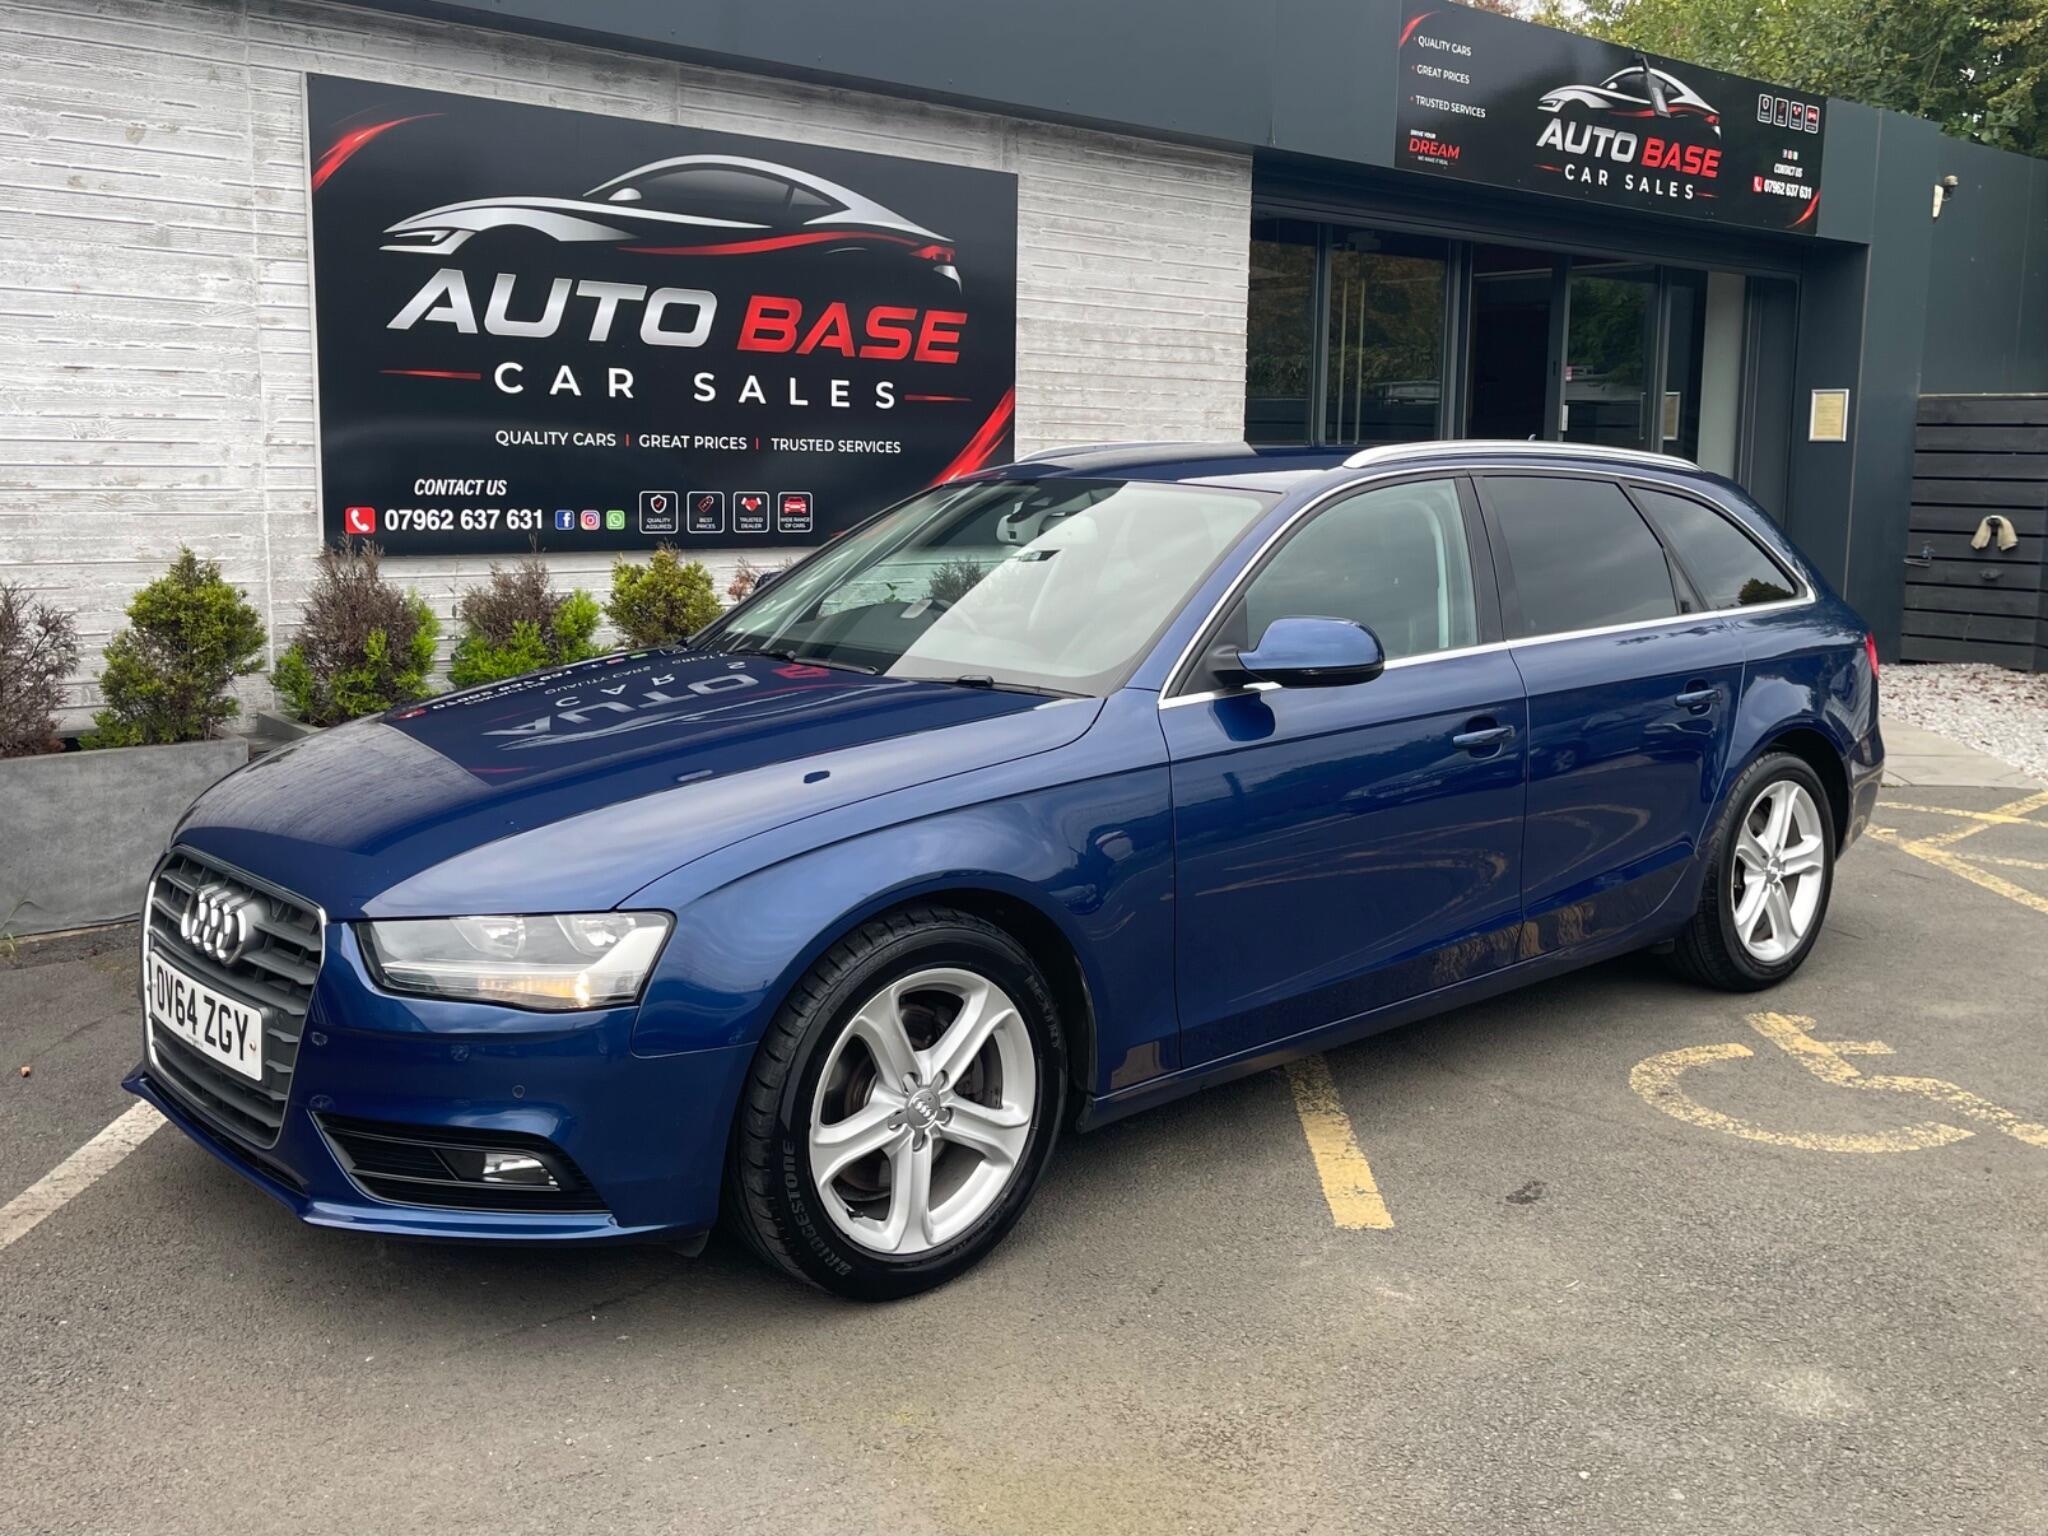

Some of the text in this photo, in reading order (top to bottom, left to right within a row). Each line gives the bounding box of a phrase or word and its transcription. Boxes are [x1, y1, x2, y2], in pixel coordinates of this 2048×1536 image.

[1418, 35, 1472, 57] QUALITY CARS
[1416, 64, 1470, 84] GREAT PRICES
[1415, 95, 1486, 118] TRUSTED SERVICES
[1409, 137, 1460, 159] DREAM
[1536, 118, 1722, 178] AUTO BASE
[1564, 163, 1694, 200] CAR SALES
[1773, 163, 1803, 178] CONTACT US
[1764, 179, 1812, 200] 07962 637 631
[386, 268, 968, 364] AUTO BASE
[494, 362, 897, 410] CAR SALES
[495, 430, 902, 454] QUALITY CARS GREAT PRICES TRUSTED SERVICES
[414, 478, 508, 496] CONTACT US
[384, 508, 543, 531] 07962 637 631
[156, 963, 248, 1062] OV64 ZGY
[783, 1139, 853, 1276] BRIDGESTONE
